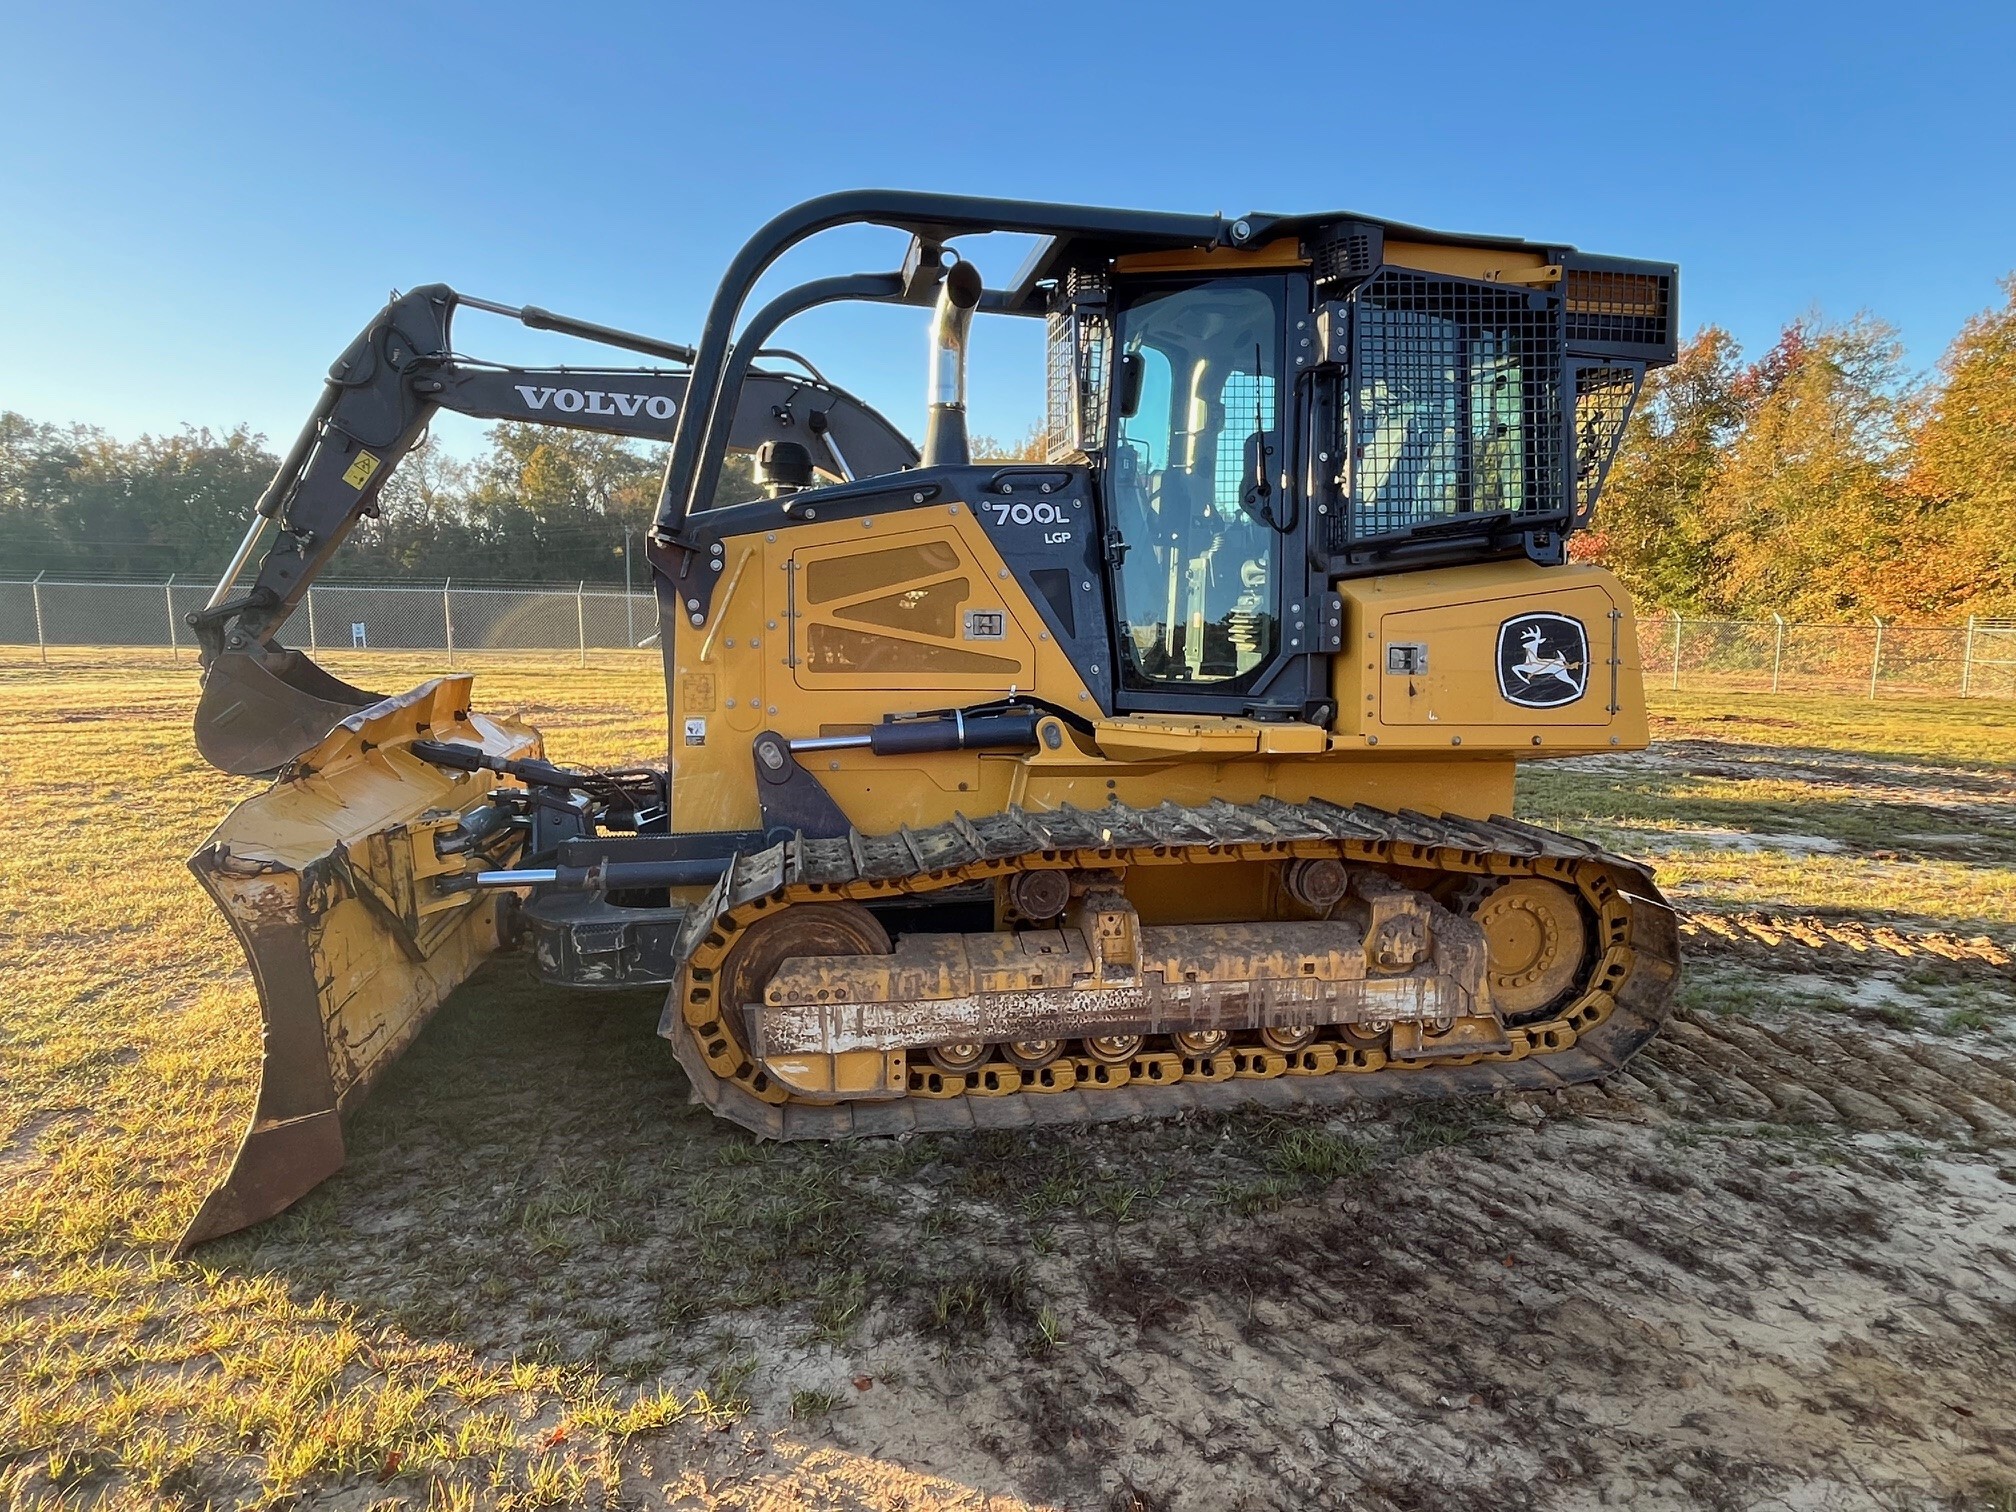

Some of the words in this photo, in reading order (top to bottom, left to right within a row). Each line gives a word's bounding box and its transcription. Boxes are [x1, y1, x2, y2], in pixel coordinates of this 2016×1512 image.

[514, 385, 677, 420] VOLVO
[991, 502, 1070, 526] 700L
[1044, 532, 1072, 544] LGP
